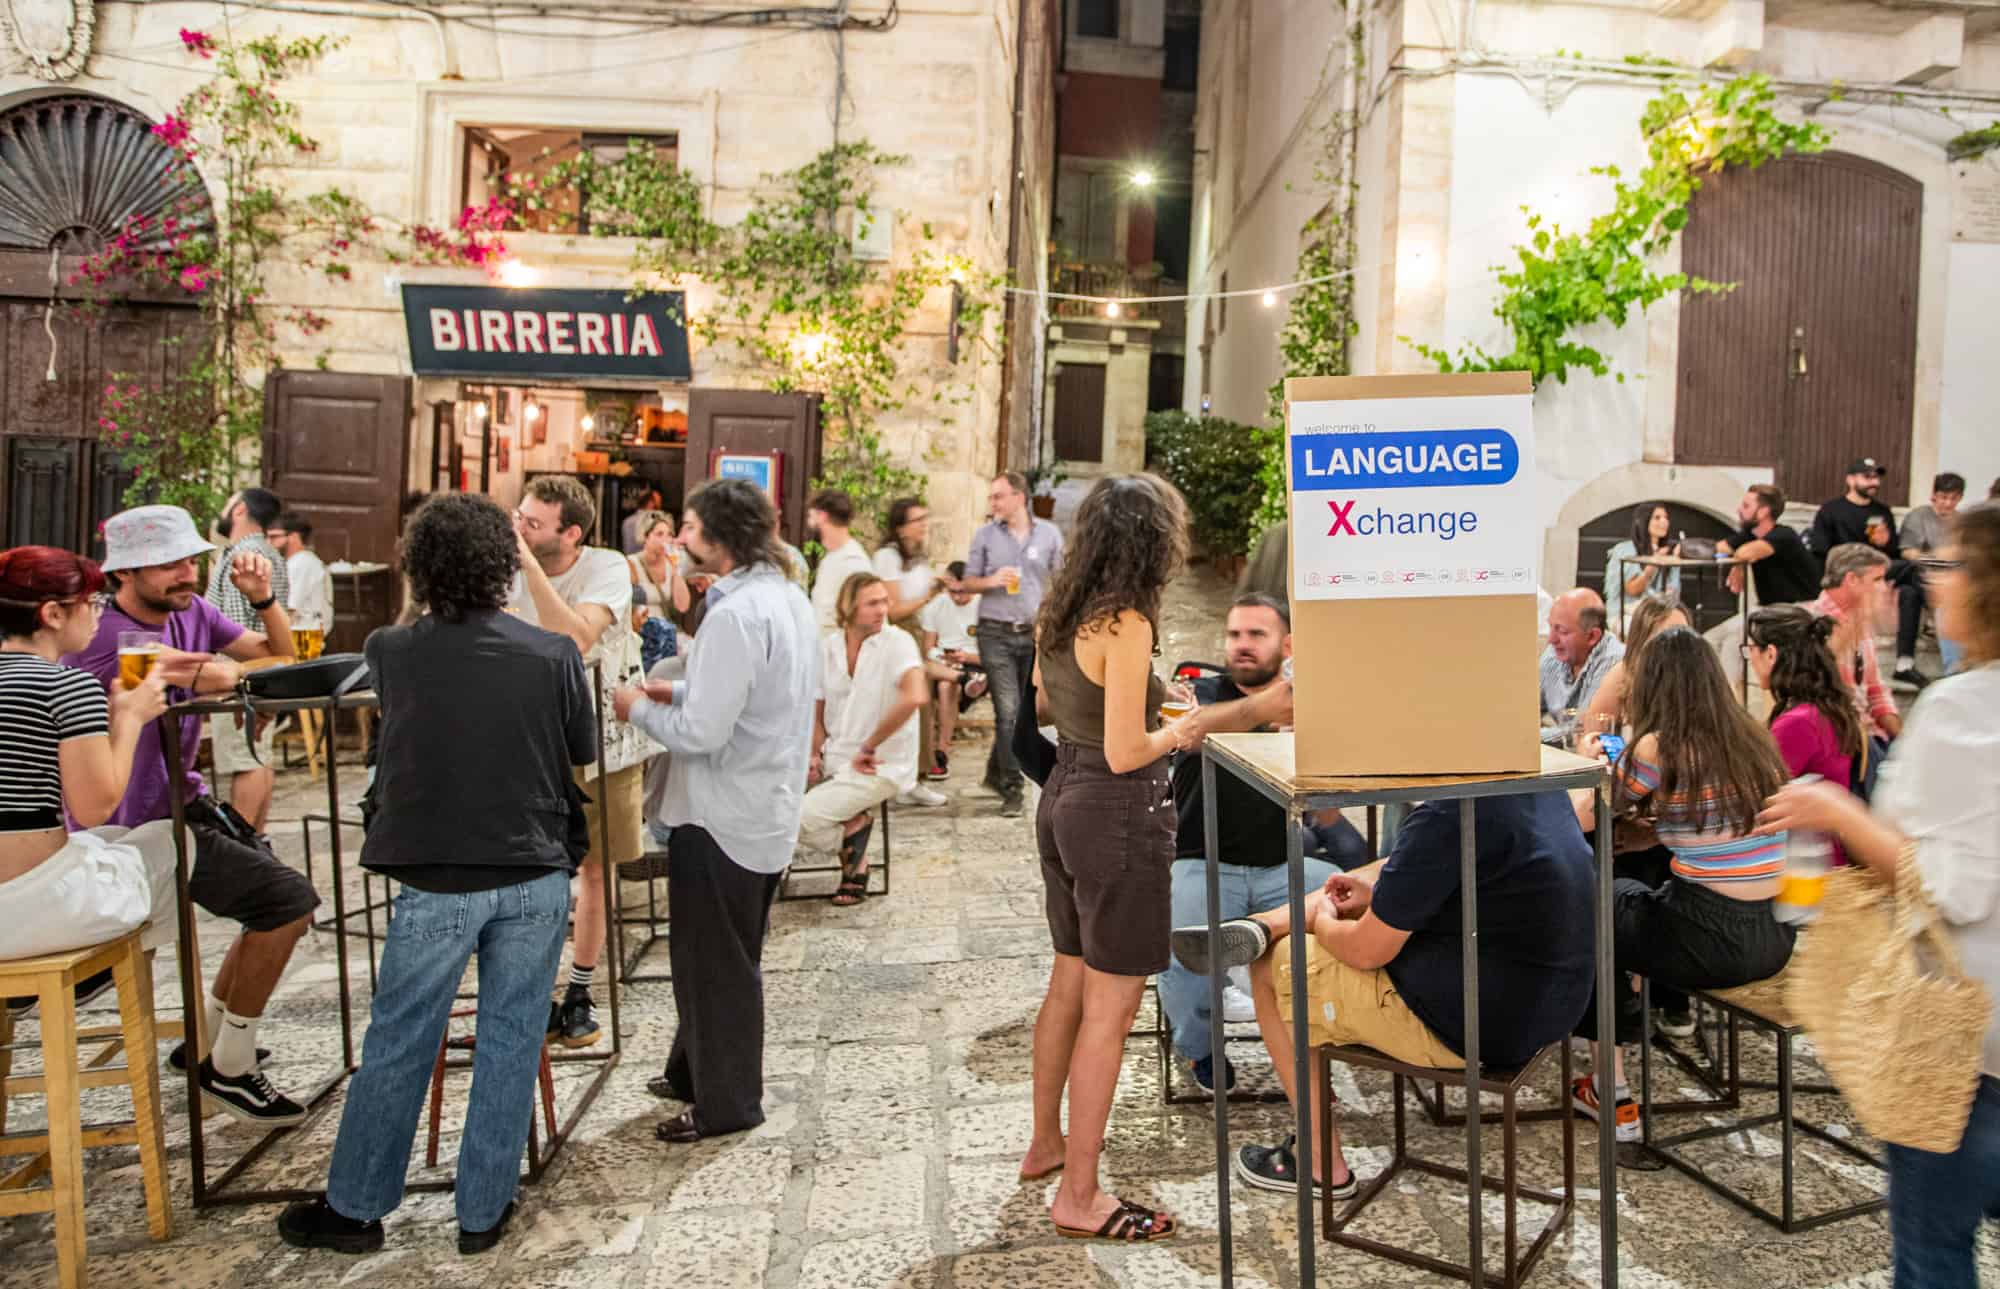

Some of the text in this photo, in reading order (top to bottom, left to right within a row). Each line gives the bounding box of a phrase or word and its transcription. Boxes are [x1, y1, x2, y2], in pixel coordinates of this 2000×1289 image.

[429, 308, 663, 356] BIRRERIA
[1304, 424, 1376, 436] welcome to
[1305, 443, 1503, 476] LANGUAGE
[1327, 501, 1478, 540] Xchange
